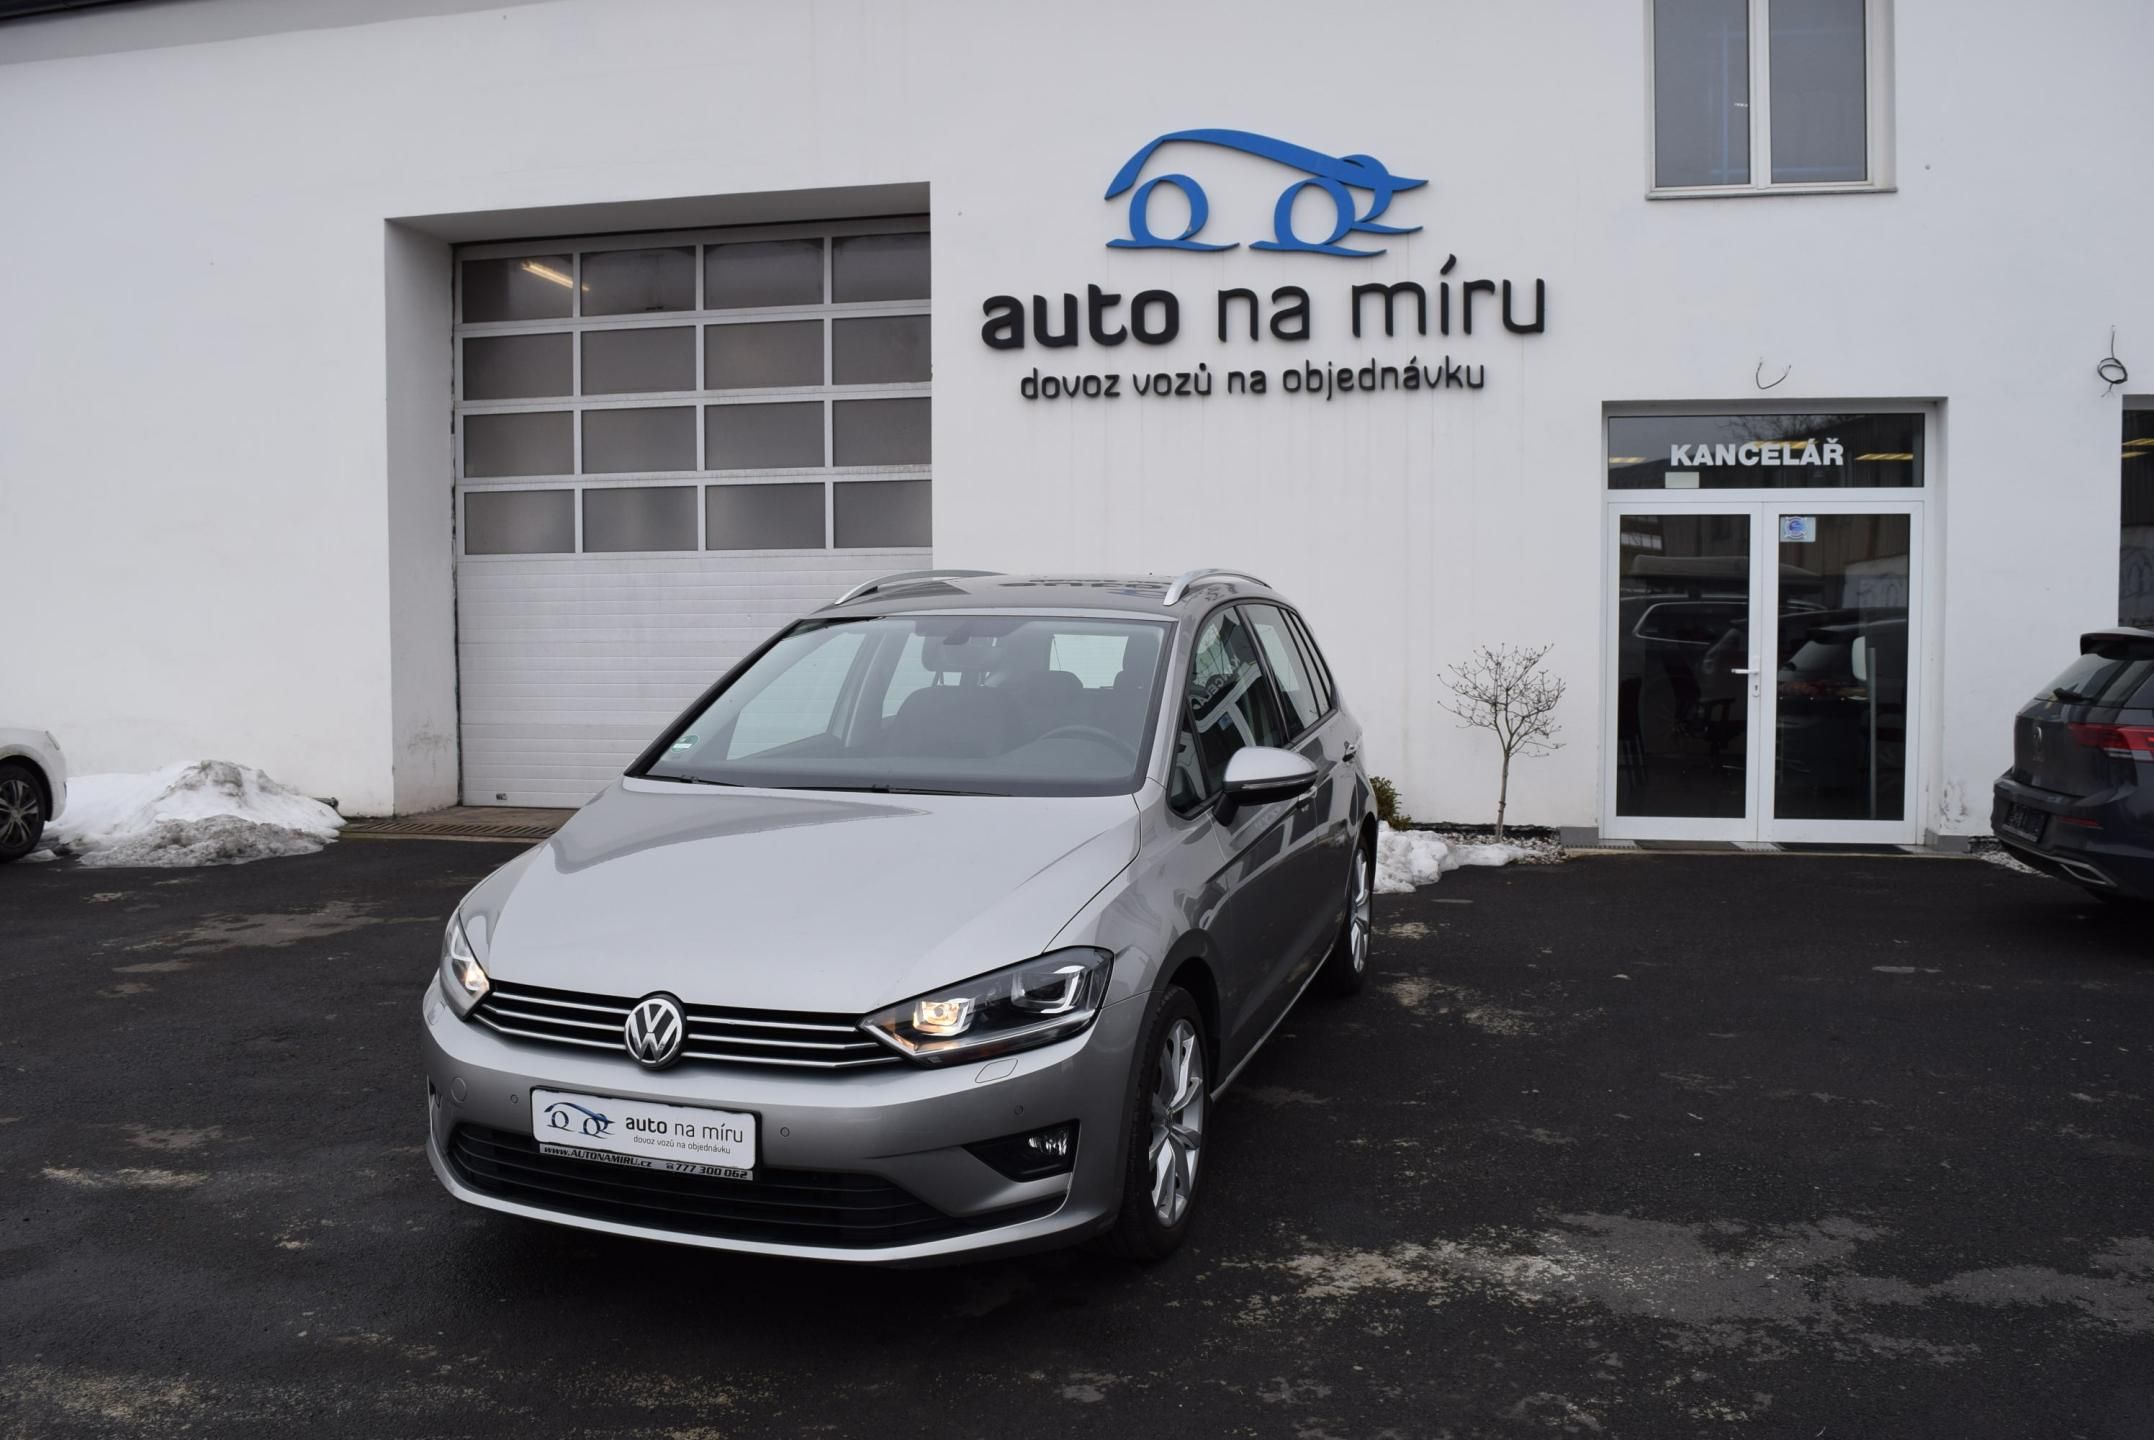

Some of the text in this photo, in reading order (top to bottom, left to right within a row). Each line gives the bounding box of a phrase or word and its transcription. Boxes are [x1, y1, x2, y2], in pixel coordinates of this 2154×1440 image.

[982, 253, 1546, 351] auto na míru
[1020, 356, 1485, 402] dovoz vozů na objednávku
[1670, 437, 1845, 467] KANCELÁŘ
[625, 1116, 743, 1143] auto na míru
[633, 1135, 655, 1145] dovoz
[656, 1139, 675, 1148] vozů
[687, 1142, 731, 1154] objednávku
[675, 1163, 697, 1173] 777
[699, 1165, 722, 1176] 300
